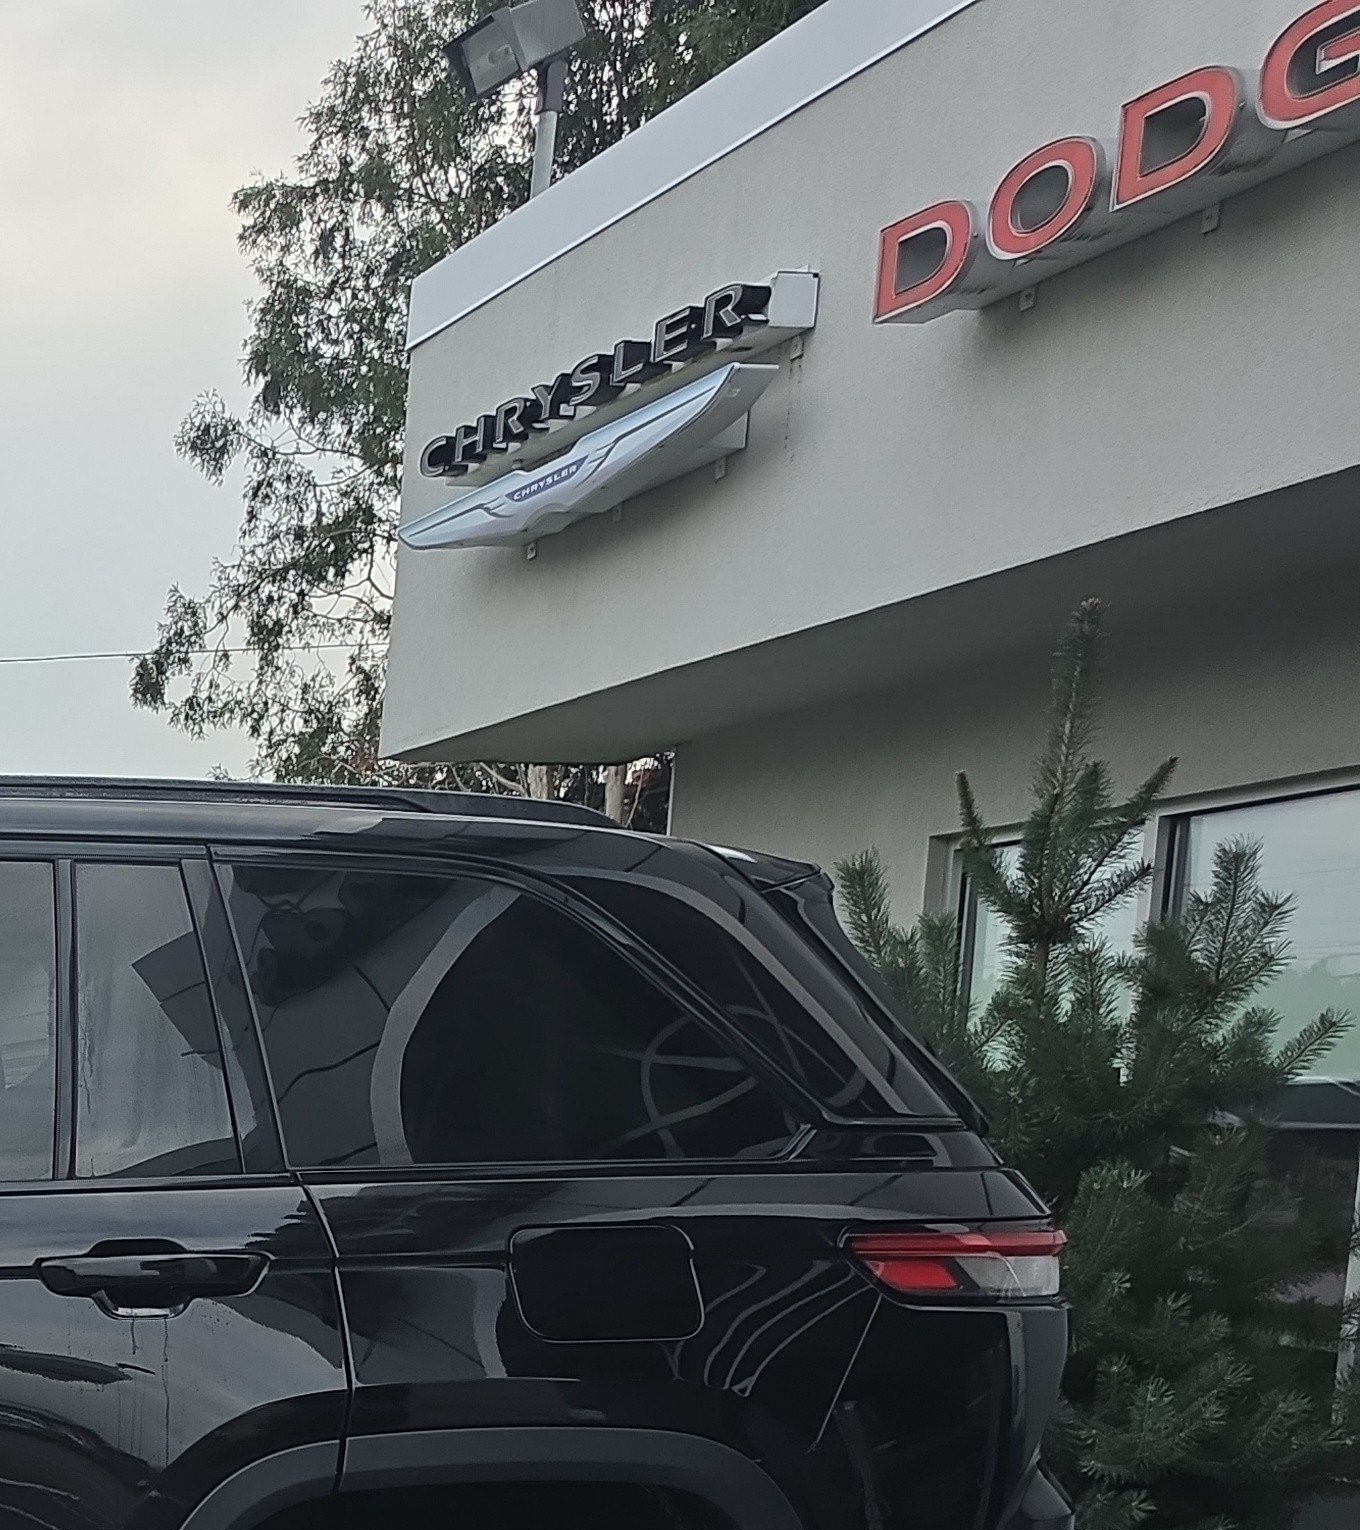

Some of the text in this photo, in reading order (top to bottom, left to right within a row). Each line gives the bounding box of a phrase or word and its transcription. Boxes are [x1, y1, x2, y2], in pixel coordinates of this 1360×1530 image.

[872, 0, 1360, 324] DODG
[420, 284, 764, 477] CHRYSLER
[511, 464, 579, 501] CHRYSLER
